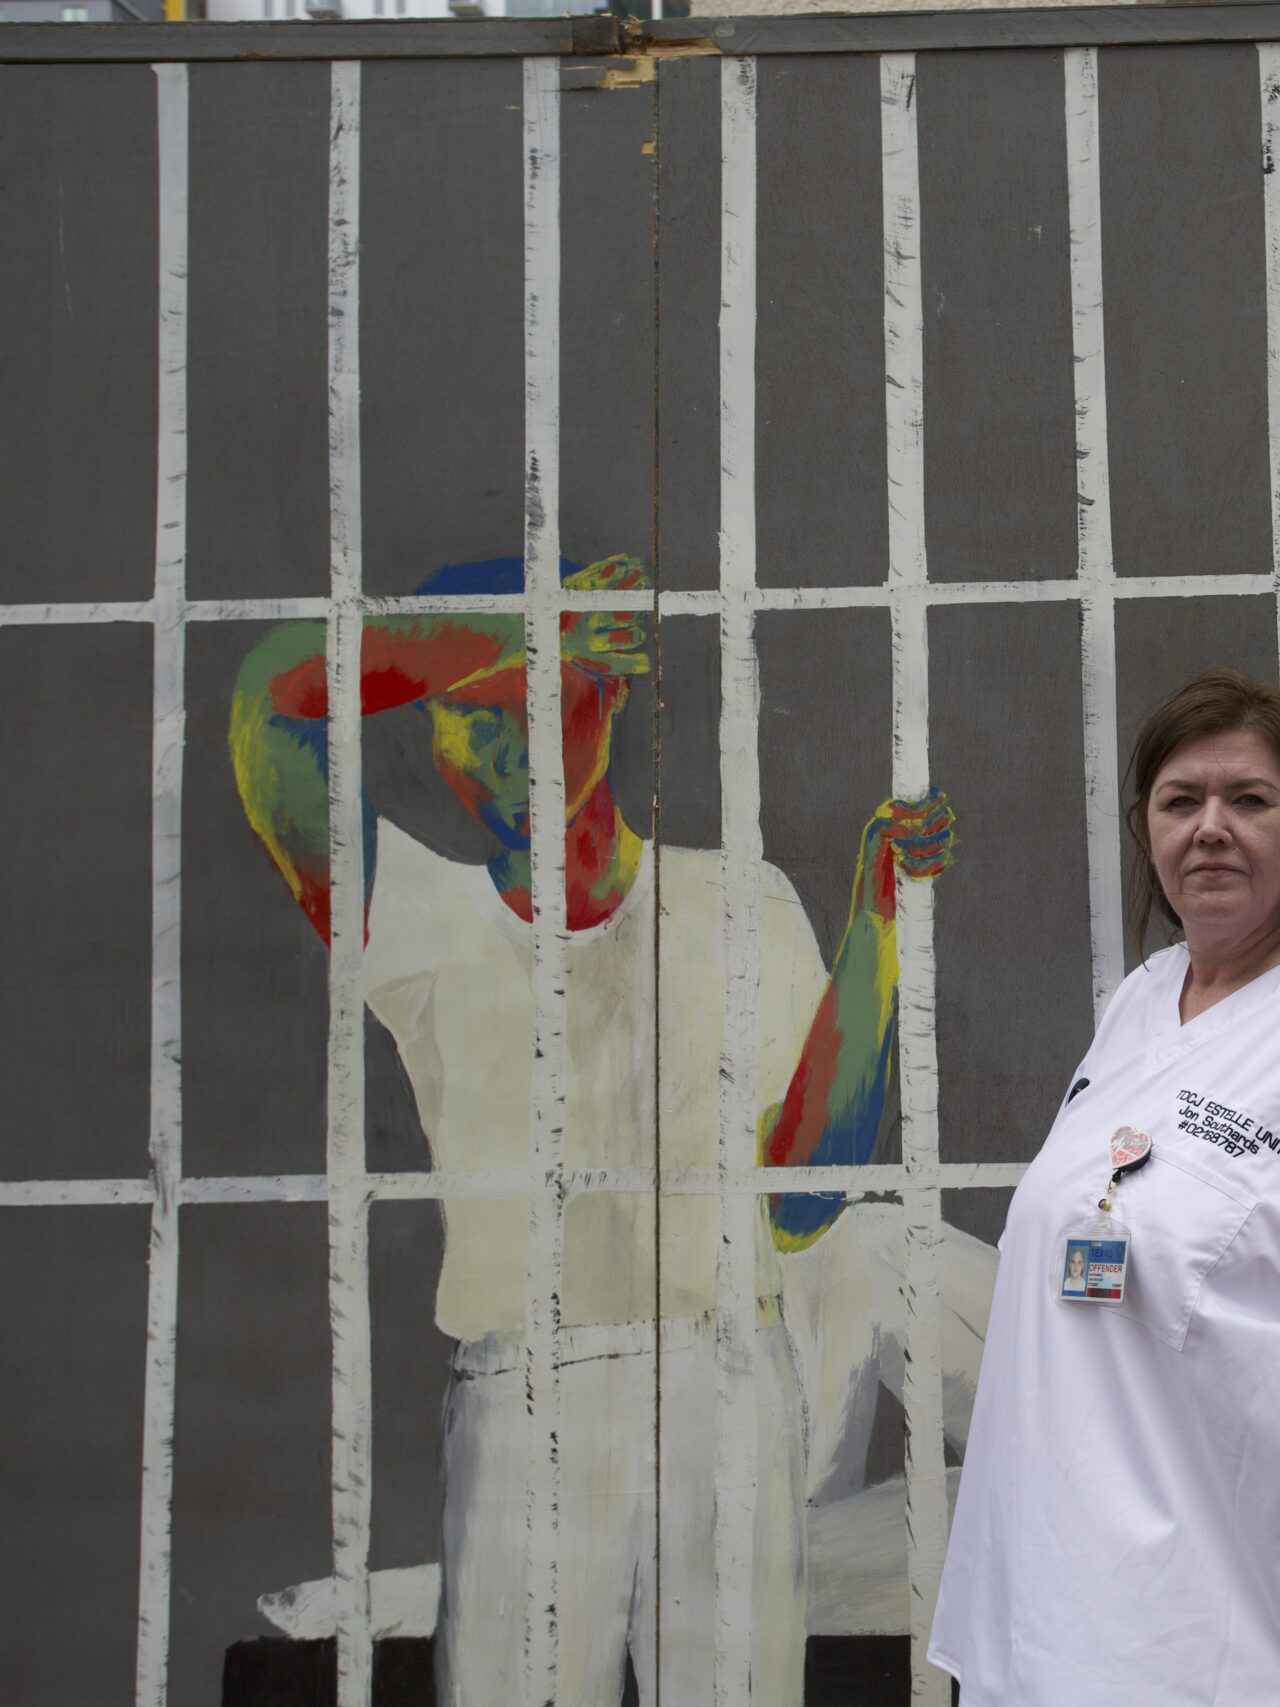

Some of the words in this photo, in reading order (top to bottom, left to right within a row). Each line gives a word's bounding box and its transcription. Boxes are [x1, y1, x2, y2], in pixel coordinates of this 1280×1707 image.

[1176, 1089, 1205, 1107] TDCJ
[1204, 1101, 1255, 1131] ESTELLE
[1178, 1105, 1199, 1121] Jon
[1202, 1115, 1260, 1155] Southards
[1177, 1119, 1246, 1158] #02168787
[1089, 1264, 1123, 1273] OFFENDER
